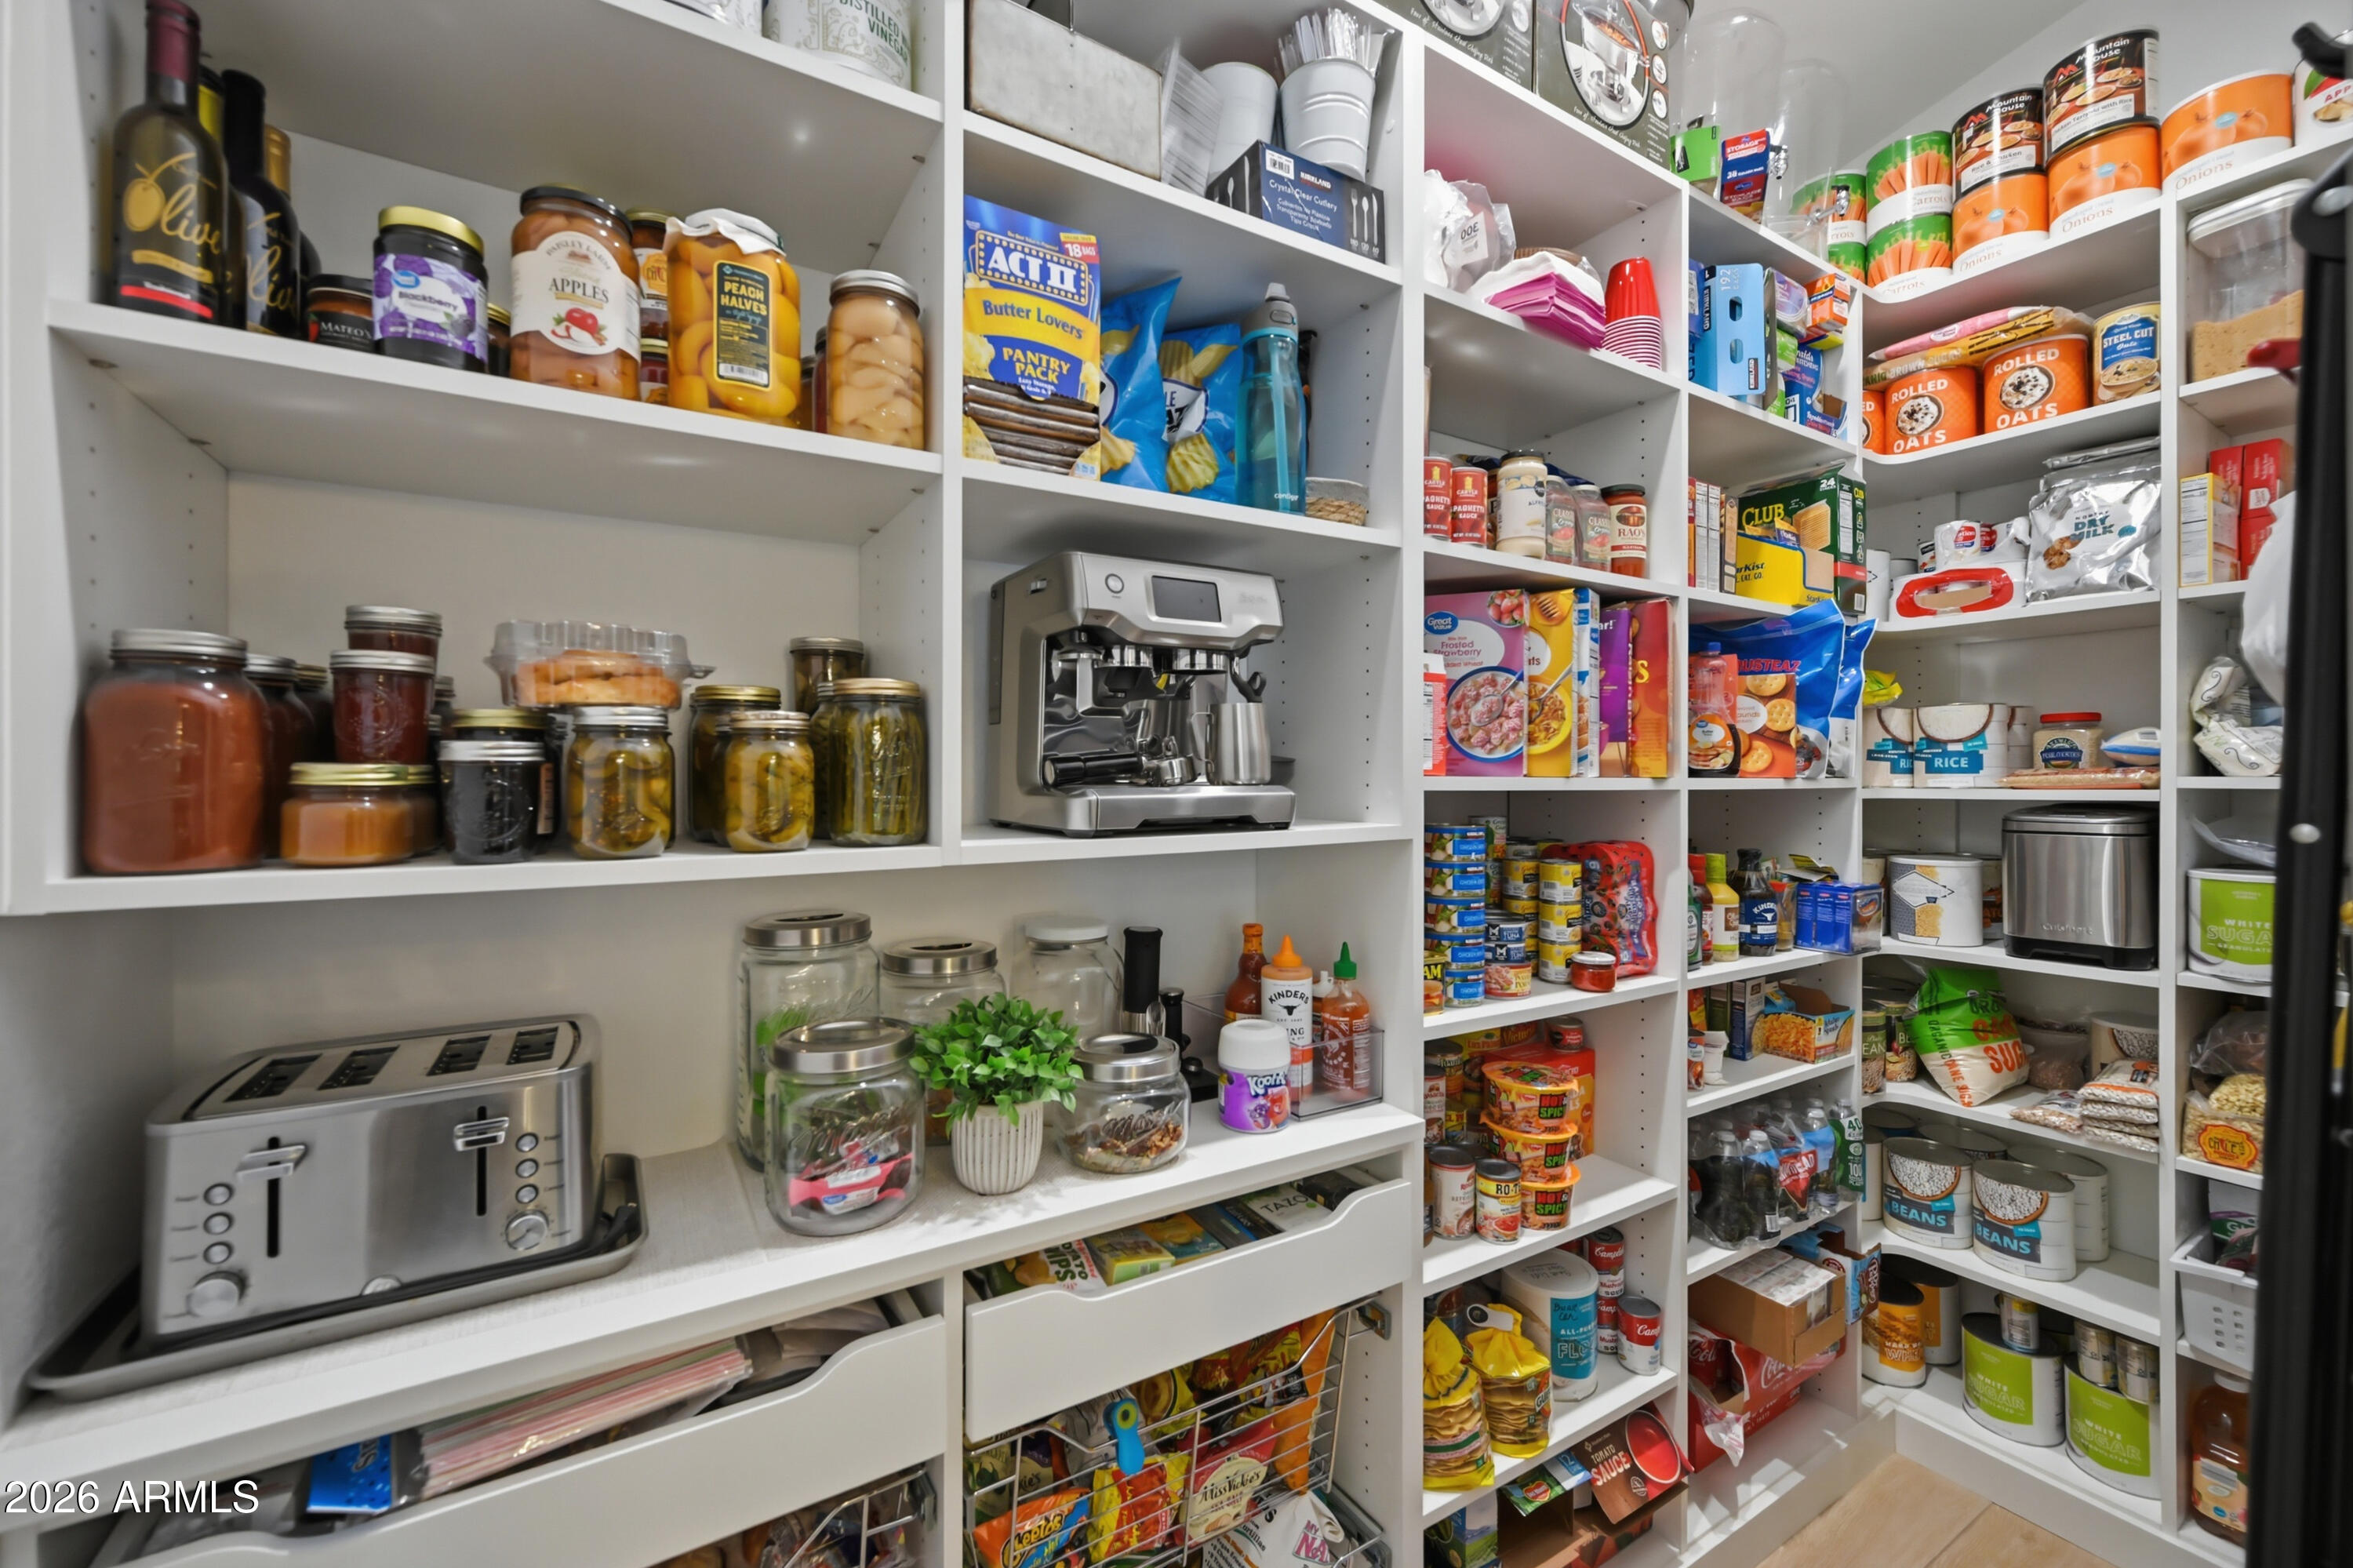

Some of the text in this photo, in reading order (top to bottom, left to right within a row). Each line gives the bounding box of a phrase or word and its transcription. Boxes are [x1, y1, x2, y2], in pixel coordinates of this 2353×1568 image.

[867, 20, 908, 66] VINEGAR
[2076, 38, 2129, 66] Muntain
[2086, 47, 2122, 65] ouse
[1997, 102, 2025, 115] ouse
[1300, 171, 1332, 189] KIRKLAND
[2175, 160, 2234, 191] Onions
[1295, 188, 1312, 201] Clear
[1314, 195, 1337, 213] Cutlery
[2061, 206, 2114, 233] Onions
[1065, 243, 1096, 258] 18 BAGS
[987, 246, 1077, 293] ACT II
[1720, 268, 1731, 291] 192
[548, 277, 609, 304] APPLES
[724, 280, 765, 303] PEACH
[398, 291, 458, 312] Blackberry
[720, 294, 768, 316] HALVES
[982, 300, 1083, 340] Butter Lovers
[2103, 332, 2133, 349] STEEL
[2133, 326, 2155, 339] CUT
[1002, 347, 1071, 375] PANTRY
[1889, 359, 1926, 378] BROWN
[1992, 347, 2060, 377] ROLLED
[1014, 362, 1059, 384] PACK
[1891, 378, 1949, 405] ROLLED
[1995, 402, 2059, 430] OATS
[1893, 429, 1947, 455] OATS
[1820, 477, 1836, 488] 24
[1424, 496, 1451, 505] PAGHETT
[1458, 511, 1478, 520] SAUCE
[1741, 503, 1785, 529] CLUB
[2075, 514, 2111, 533] DRY
[1735, 562, 1766, 574] arKist
[1427, 617, 1453, 626] Great
[1441, 640, 1475, 649] Frosted
[1899, 758, 1914, 769] RIC
[1933, 757, 1969, 768] RICE
[2224, 918, 2271, 930] WHITE
[2206, 925, 2272, 946] SUGA
[1424, 964, 1442, 980] AM
[1286, 1027, 1305, 1037] ING
[1862, 1042, 1886, 1055] EAN
[1540, 1093, 1563, 1107] HOT
[1847, 1119, 1864, 1132] 40
[1545, 1142, 1568, 1155] HOT
[1544, 1155, 1567, 1167] SPIC
[1260, 1194, 1309, 1215] TAZO
[1536, 1191, 1562, 1203] HOT
[1890, 1201, 1947, 1228] BEANS
[1975, 1225, 2031, 1255] BEANS
[1977, 1373, 2009, 1392] WHITE
[2084, 1418, 2122, 1440] WHITE
[1591, 1444, 1616, 1464] TOMATO
[1591, 1452, 1631, 1487] SAUCE
[1242, 1523, 1267, 1552] ortillas
